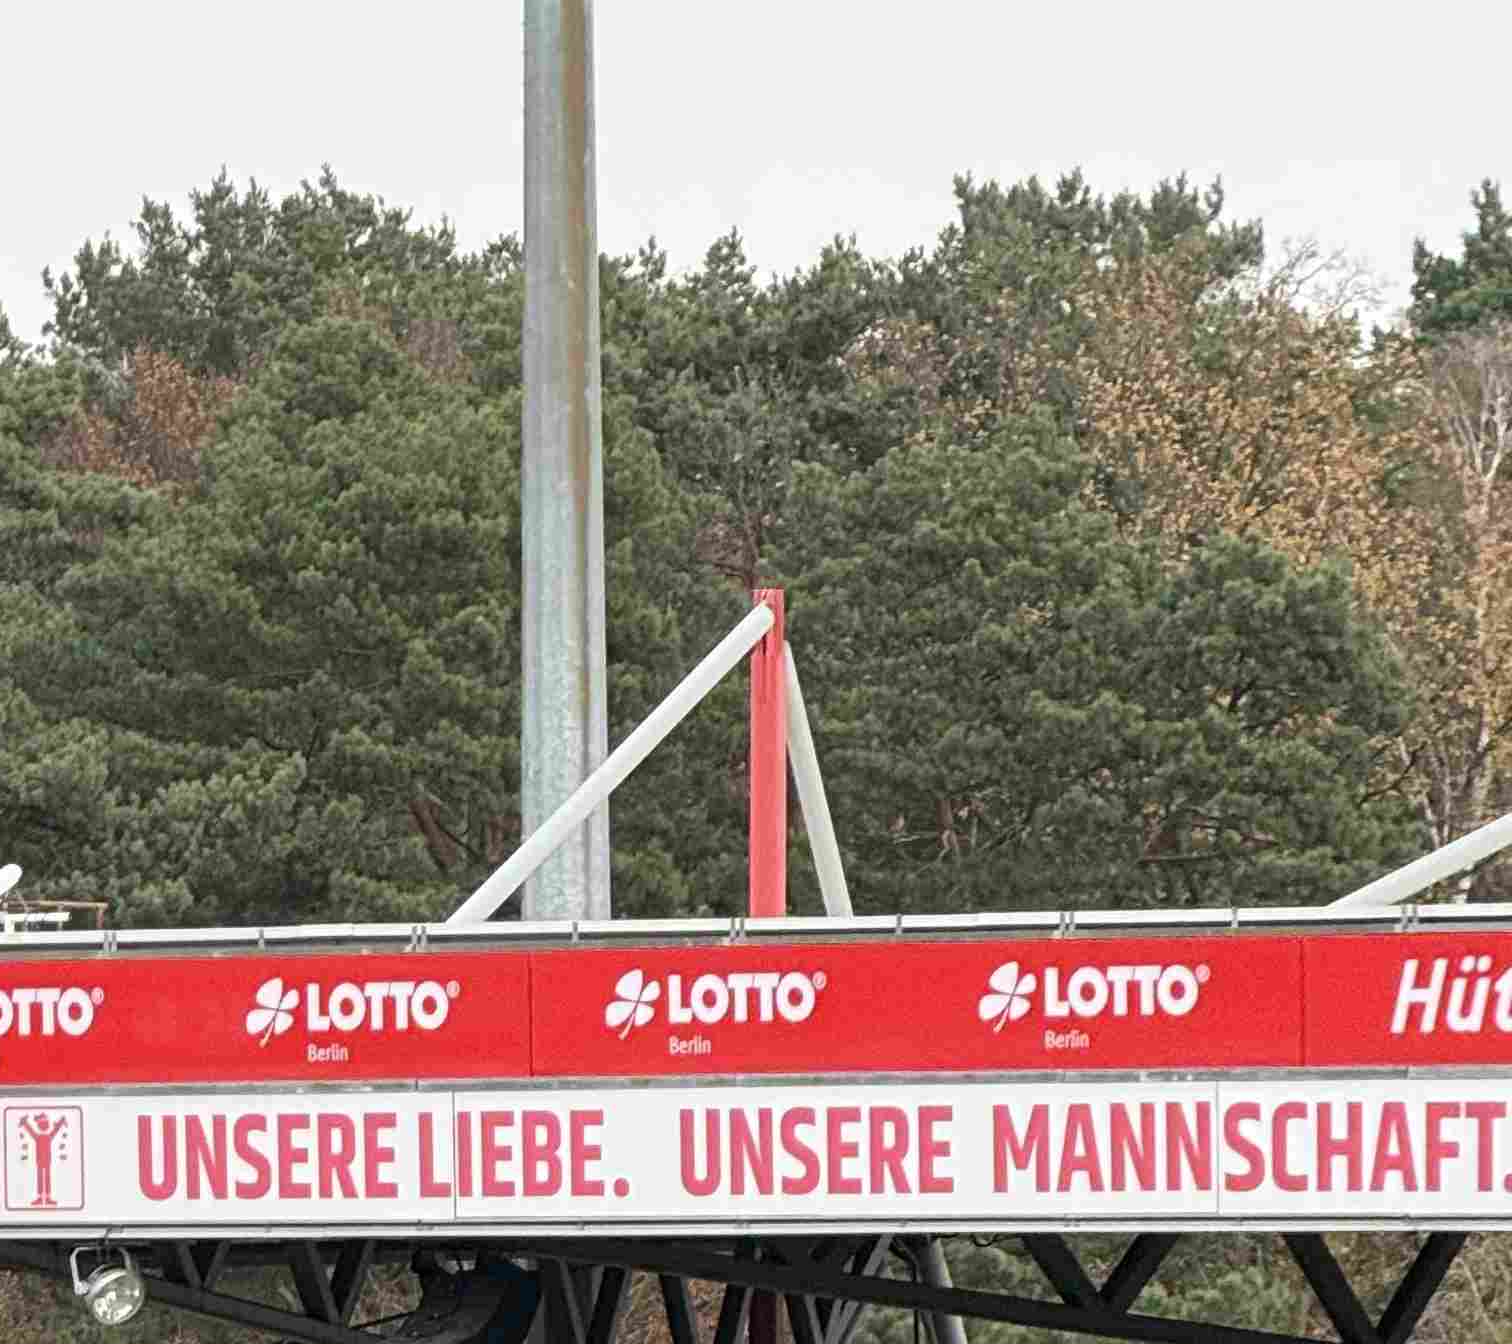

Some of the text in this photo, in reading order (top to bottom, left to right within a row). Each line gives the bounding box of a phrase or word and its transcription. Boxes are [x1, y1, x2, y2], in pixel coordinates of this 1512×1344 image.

[668, 1035, 712, 1055] Berlin
[1045, 1029, 1089, 1049] Berlin
[307, 1044, 349, 1062] Berlin
[137, 1112, 397, 1201] UNSERE
[418, 1109, 630, 1199] LIEBE.
[679, 1105, 954, 1198] UNSERE
